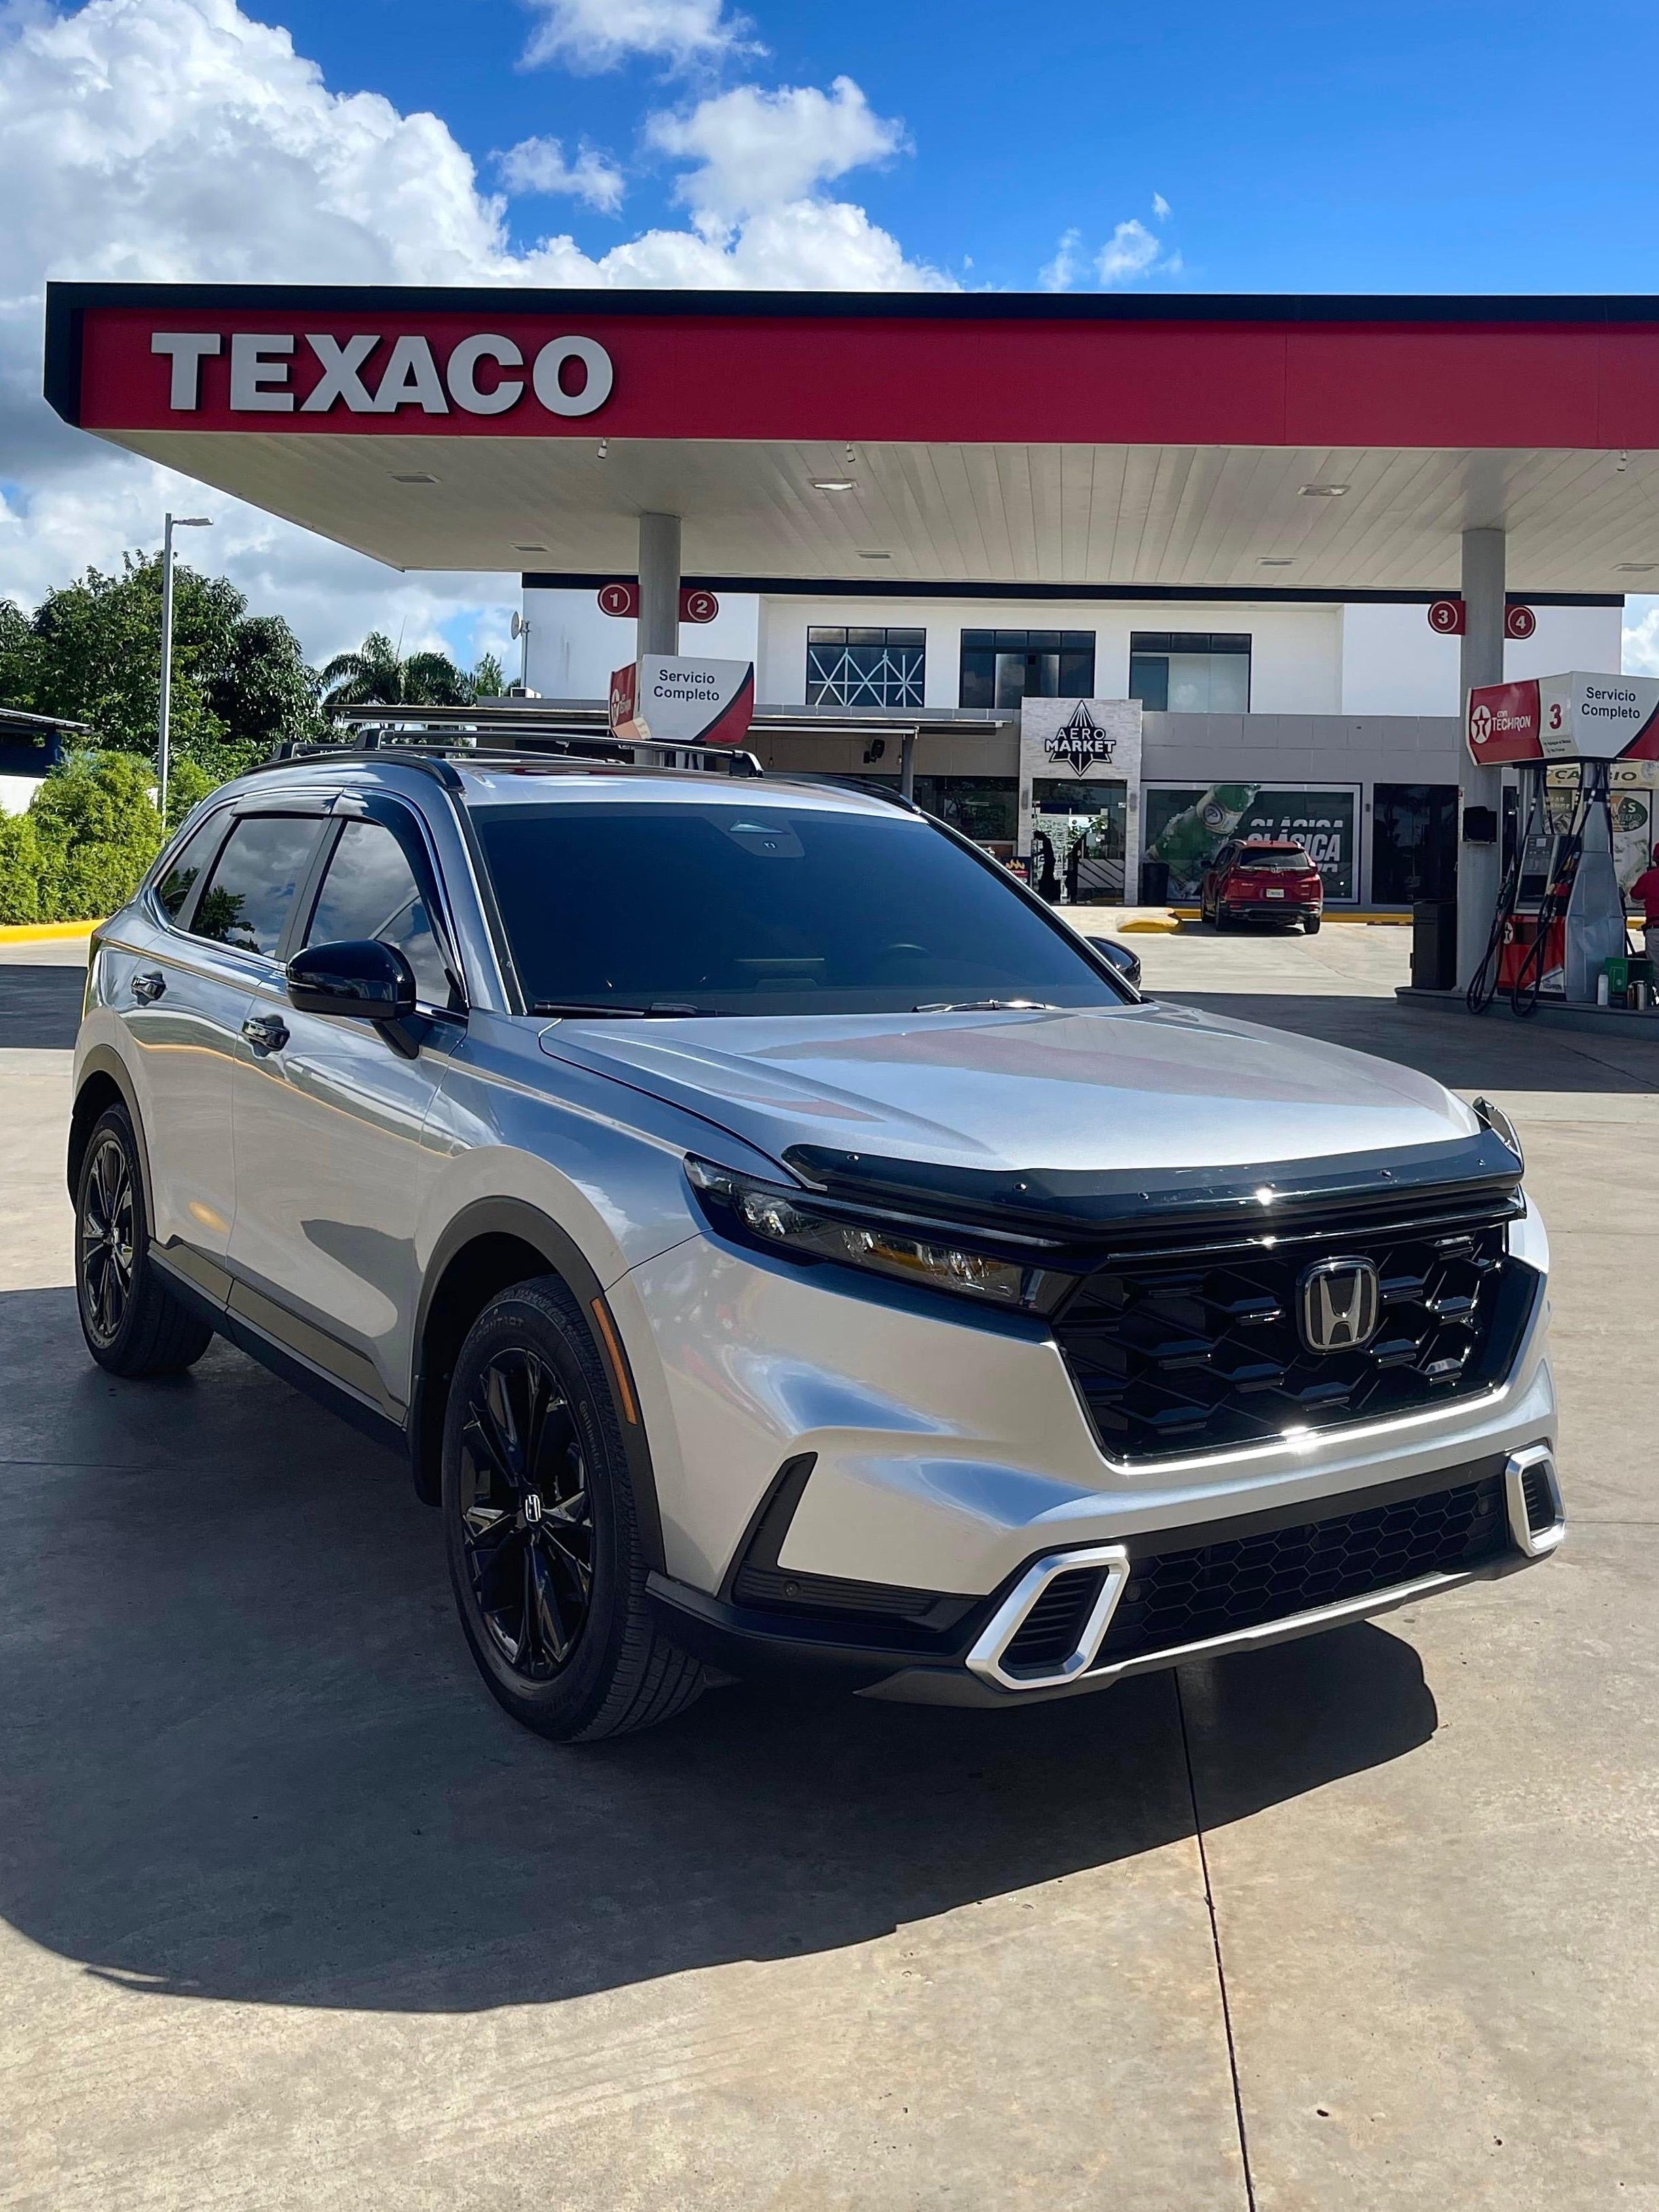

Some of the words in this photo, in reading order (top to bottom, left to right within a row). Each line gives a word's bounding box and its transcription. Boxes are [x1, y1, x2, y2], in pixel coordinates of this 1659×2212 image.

[151, 333, 614, 417] TEXACO
[610, 593, 618, 607] 1
[696, 599, 708, 614] 2
[1437, 610, 1449, 624] 3
[1515, 616, 1526, 629] 4
[659, 669, 715, 684] Servicio
[654, 686, 720, 702] Completo
[1586, 687, 1636, 702] Servicio
[1550, 703, 1561, 730] 3
[1582, 703, 1640, 719] Completo
[1492, 715, 1531, 732] TECHRON
[1056, 728, 1105, 740] AERO
[1045, 740, 1115, 753] MARKET
